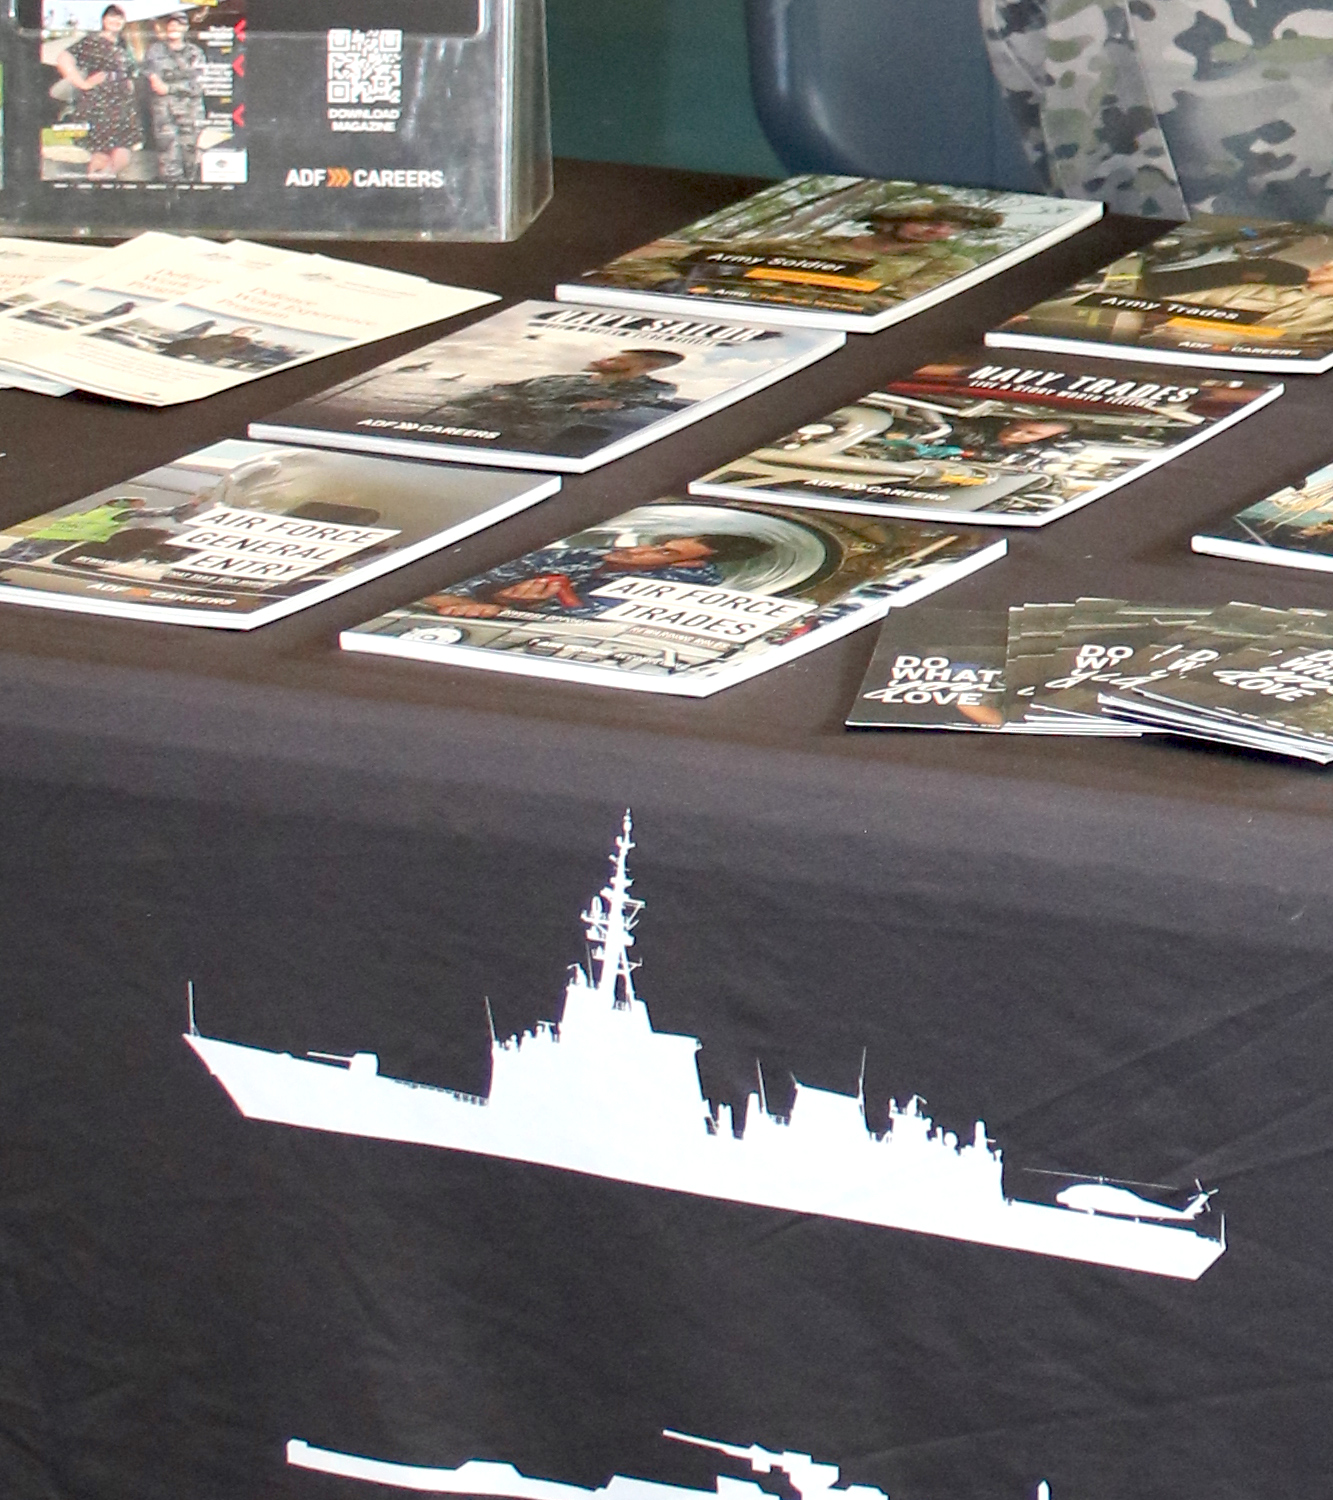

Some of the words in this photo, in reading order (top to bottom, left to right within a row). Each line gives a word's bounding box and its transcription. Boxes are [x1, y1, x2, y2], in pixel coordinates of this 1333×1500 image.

[327, 108, 400, 119] DOWNLOAD
[331, 121, 397, 132] MAGAZINE
[285, 168, 327, 187] ADF
[352, 169, 446, 188] CAREERS
[707, 252, 765, 266] Army
[767, 256, 847, 272] Soldier
[1101, 297, 1161, 311] Army
[1167, 303, 1240, 320] Trades
[550, 310, 643, 328] NAVY
[641, 319, 766, 341] SAILOR
[1178, 340, 1213, 349] ADF
[1231, 346, 1303, 356] CAREERS
[968, 365, 1065, 386] NAVY
[1068, 375, 1199, 402] TRADES
[356, 418, 398, 428] ADF
[417, 424, 502, 440] CAREERS
[804, 478, 852, 489] ADF
[866, 484, 950, 501] CAREERS
[205, 512, 267, 535] AIR
[266, 520, 385, 546] FORCE
[187, 532, 339, 562] GENERAL
[196, 555, 309, 577] ENTRY
[87, 583, 132, 594] ADF
[149, 591, 237, 607] CAREERS
[611, 582, 676, 597] AIR
[679, 589, 799, 618] FORCE
[619, 604, 757, 637] TRADES
[894, 655, 950, 669] DO
[1079, 644, 1134, 660] DO
[891, 667, 1003, 683] WHAT
[863, 679, 1007, 699] you
[882, 691, 983, 706] LOVE
[1218, 678, 1317, 702] LOVE
